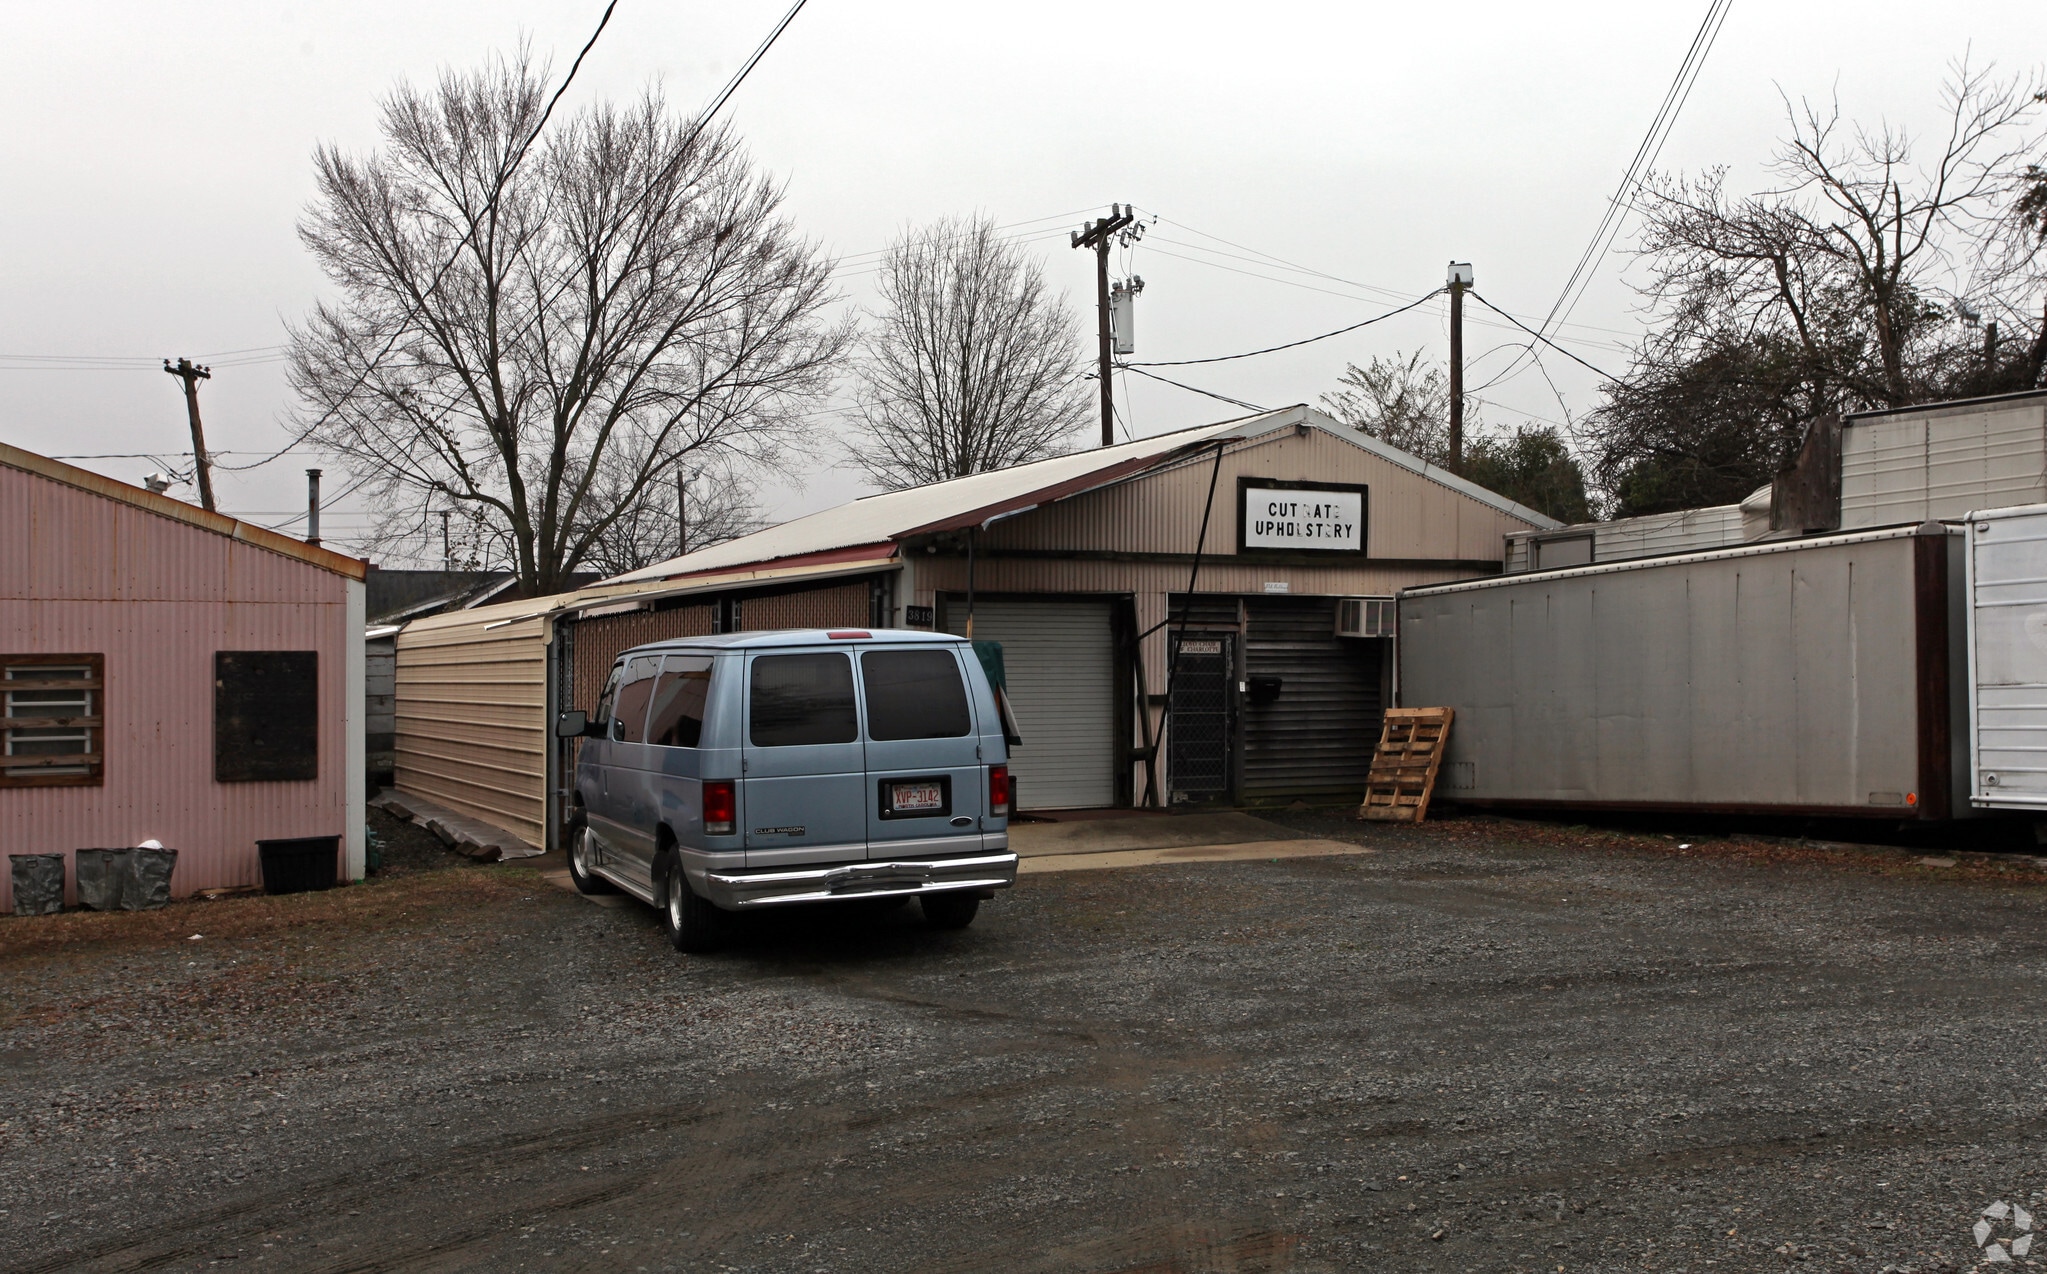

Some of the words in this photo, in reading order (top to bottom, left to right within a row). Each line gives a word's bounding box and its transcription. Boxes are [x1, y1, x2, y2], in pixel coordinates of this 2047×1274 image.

[1268, 502, 1298, 518] CUT
[907, 609, 933, 622] 3819
[895, 789, 939, 804] XVP-3142
